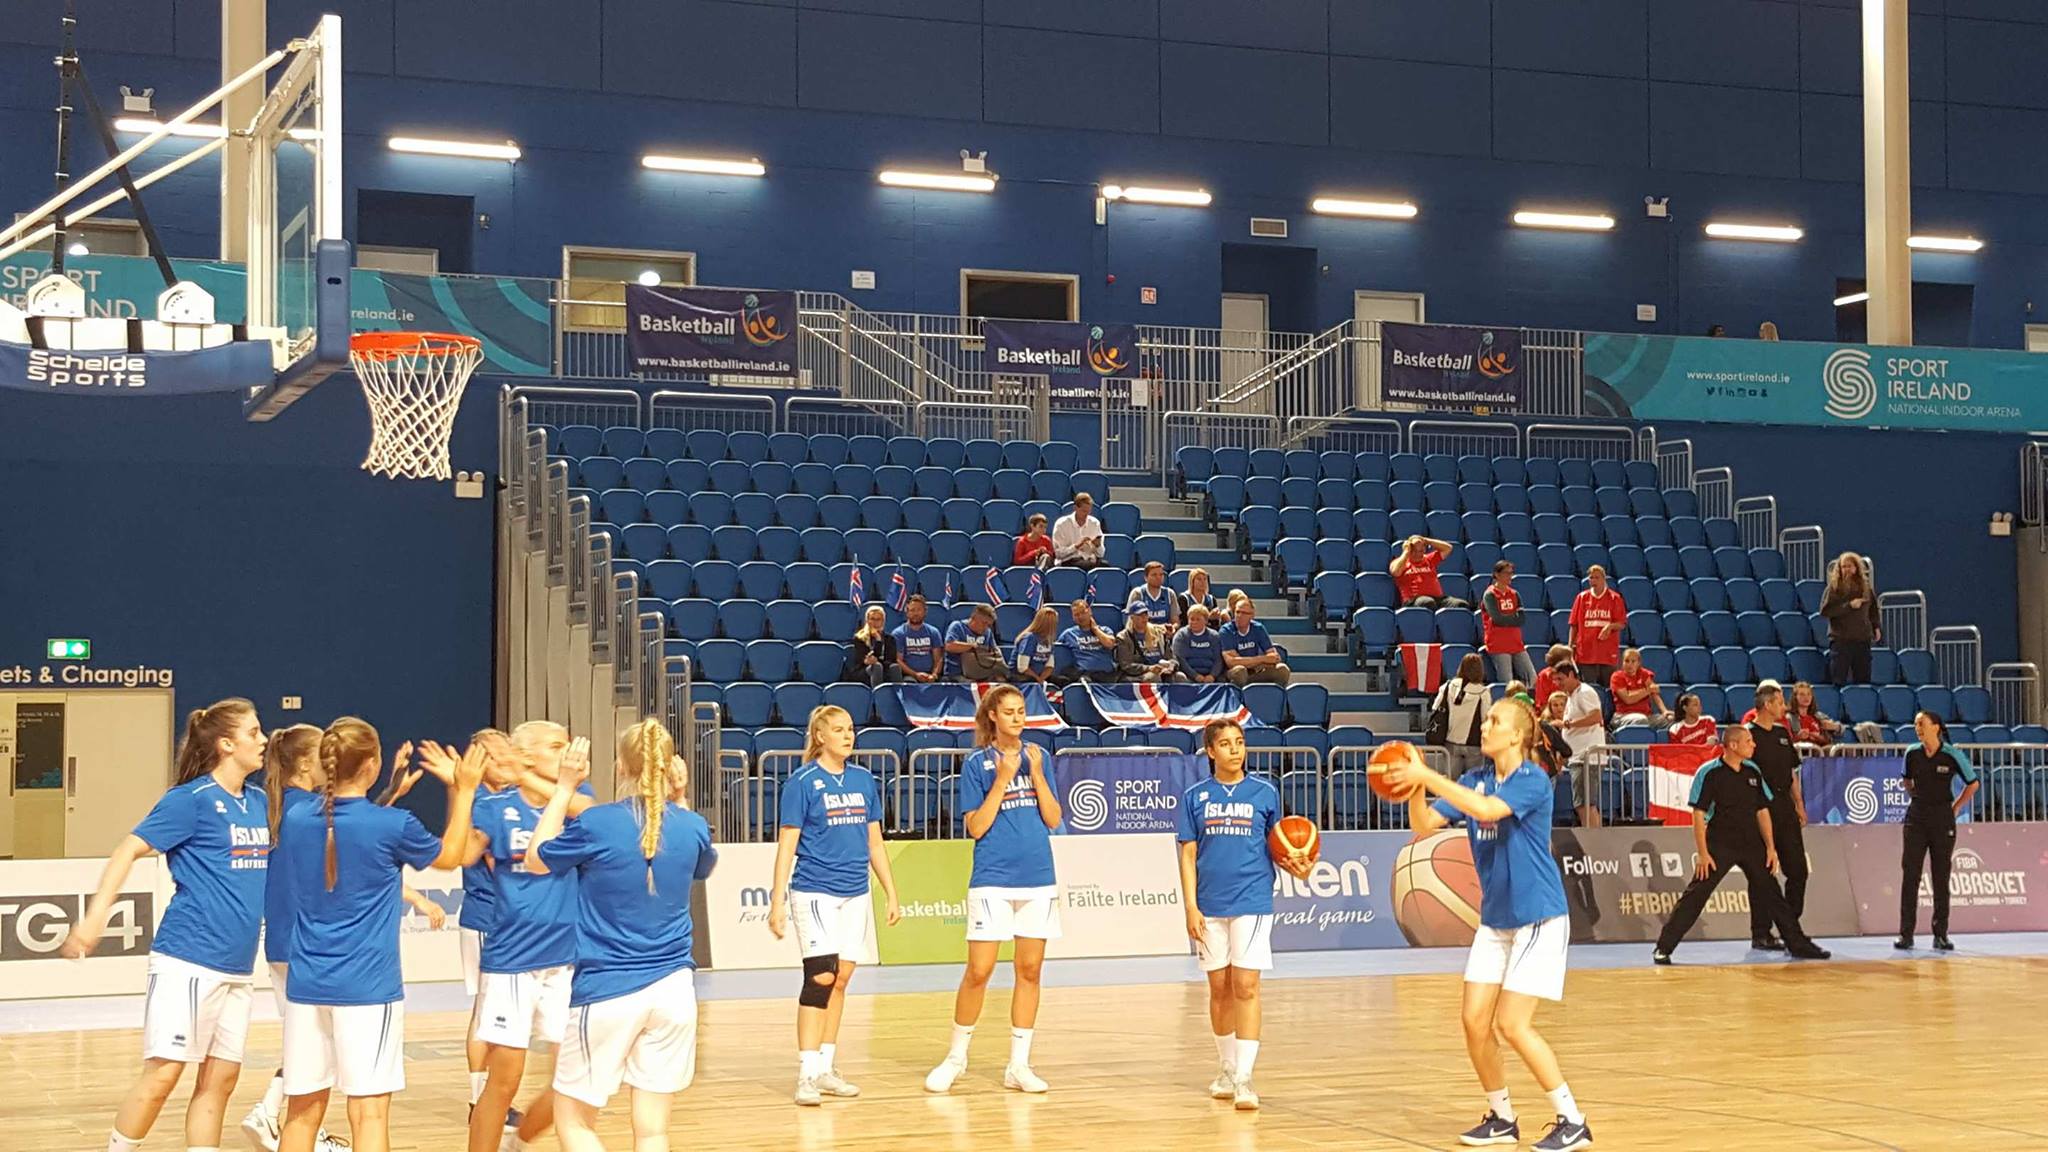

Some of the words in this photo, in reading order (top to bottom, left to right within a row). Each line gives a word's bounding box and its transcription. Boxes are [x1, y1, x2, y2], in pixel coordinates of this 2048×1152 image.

[2, 265, 102, 292] SPRT
[351, 308, 415, 321] reland.ie
[639, 314, 736, 336] Basketball
[28, 350, 146, 372] Schelde
[637, 357, 791, 372] www.basketballireland.ie
[997, 347, 1081, 366] Basketball
[1392, 349, 1473, 371] Basketball
[26, 365, 146, 387] Sports
[1886, 358, 1949, 378] SPORT
[1686, 370, 1791, 384] www.sportireland.ie
[1388, 388, 1517, 403] www.basketballireland.ie
[1887, 380, 1971, 401] IRELAND
[1887, 403, 1942, 416] NATIONAL
[1942, 405, 1985, 417] INDOOR
[1986, 406, 2022, 418] ARENA
[1584, 609, 1611, 619] AUSTRIA
[39, 666, 54, 684] &
[62, 665, 173, 687] Changing
[1115, 780, 1161, 794] SPORT
[1883, 778, 1906, 791] SPO
[823, 793, 865, 809] ÍSLAND
[1115, 796, 1178, 810] IRELAND
[1883, 792, 1912, 806] IREL
[1115, 812, 1154, 821] NATIONAL
[1204, 802, 1254, 818] ÍSLAND
[1115, 822, 1147, 830] INDOOR
[1148, 821, 1174, 829] ARENA
[230, 824, 269, 846] ÍSLAN
[1563, 855, 1619, 876] Follow
[1957, 855, 1978, 869] FIBA
[1119, 888, 1178, 906] Ireland
[886, 899, 967, 918] asketbal
[1274, 905, 1317, 925] real
[1318, 909, 1376, 931] game
